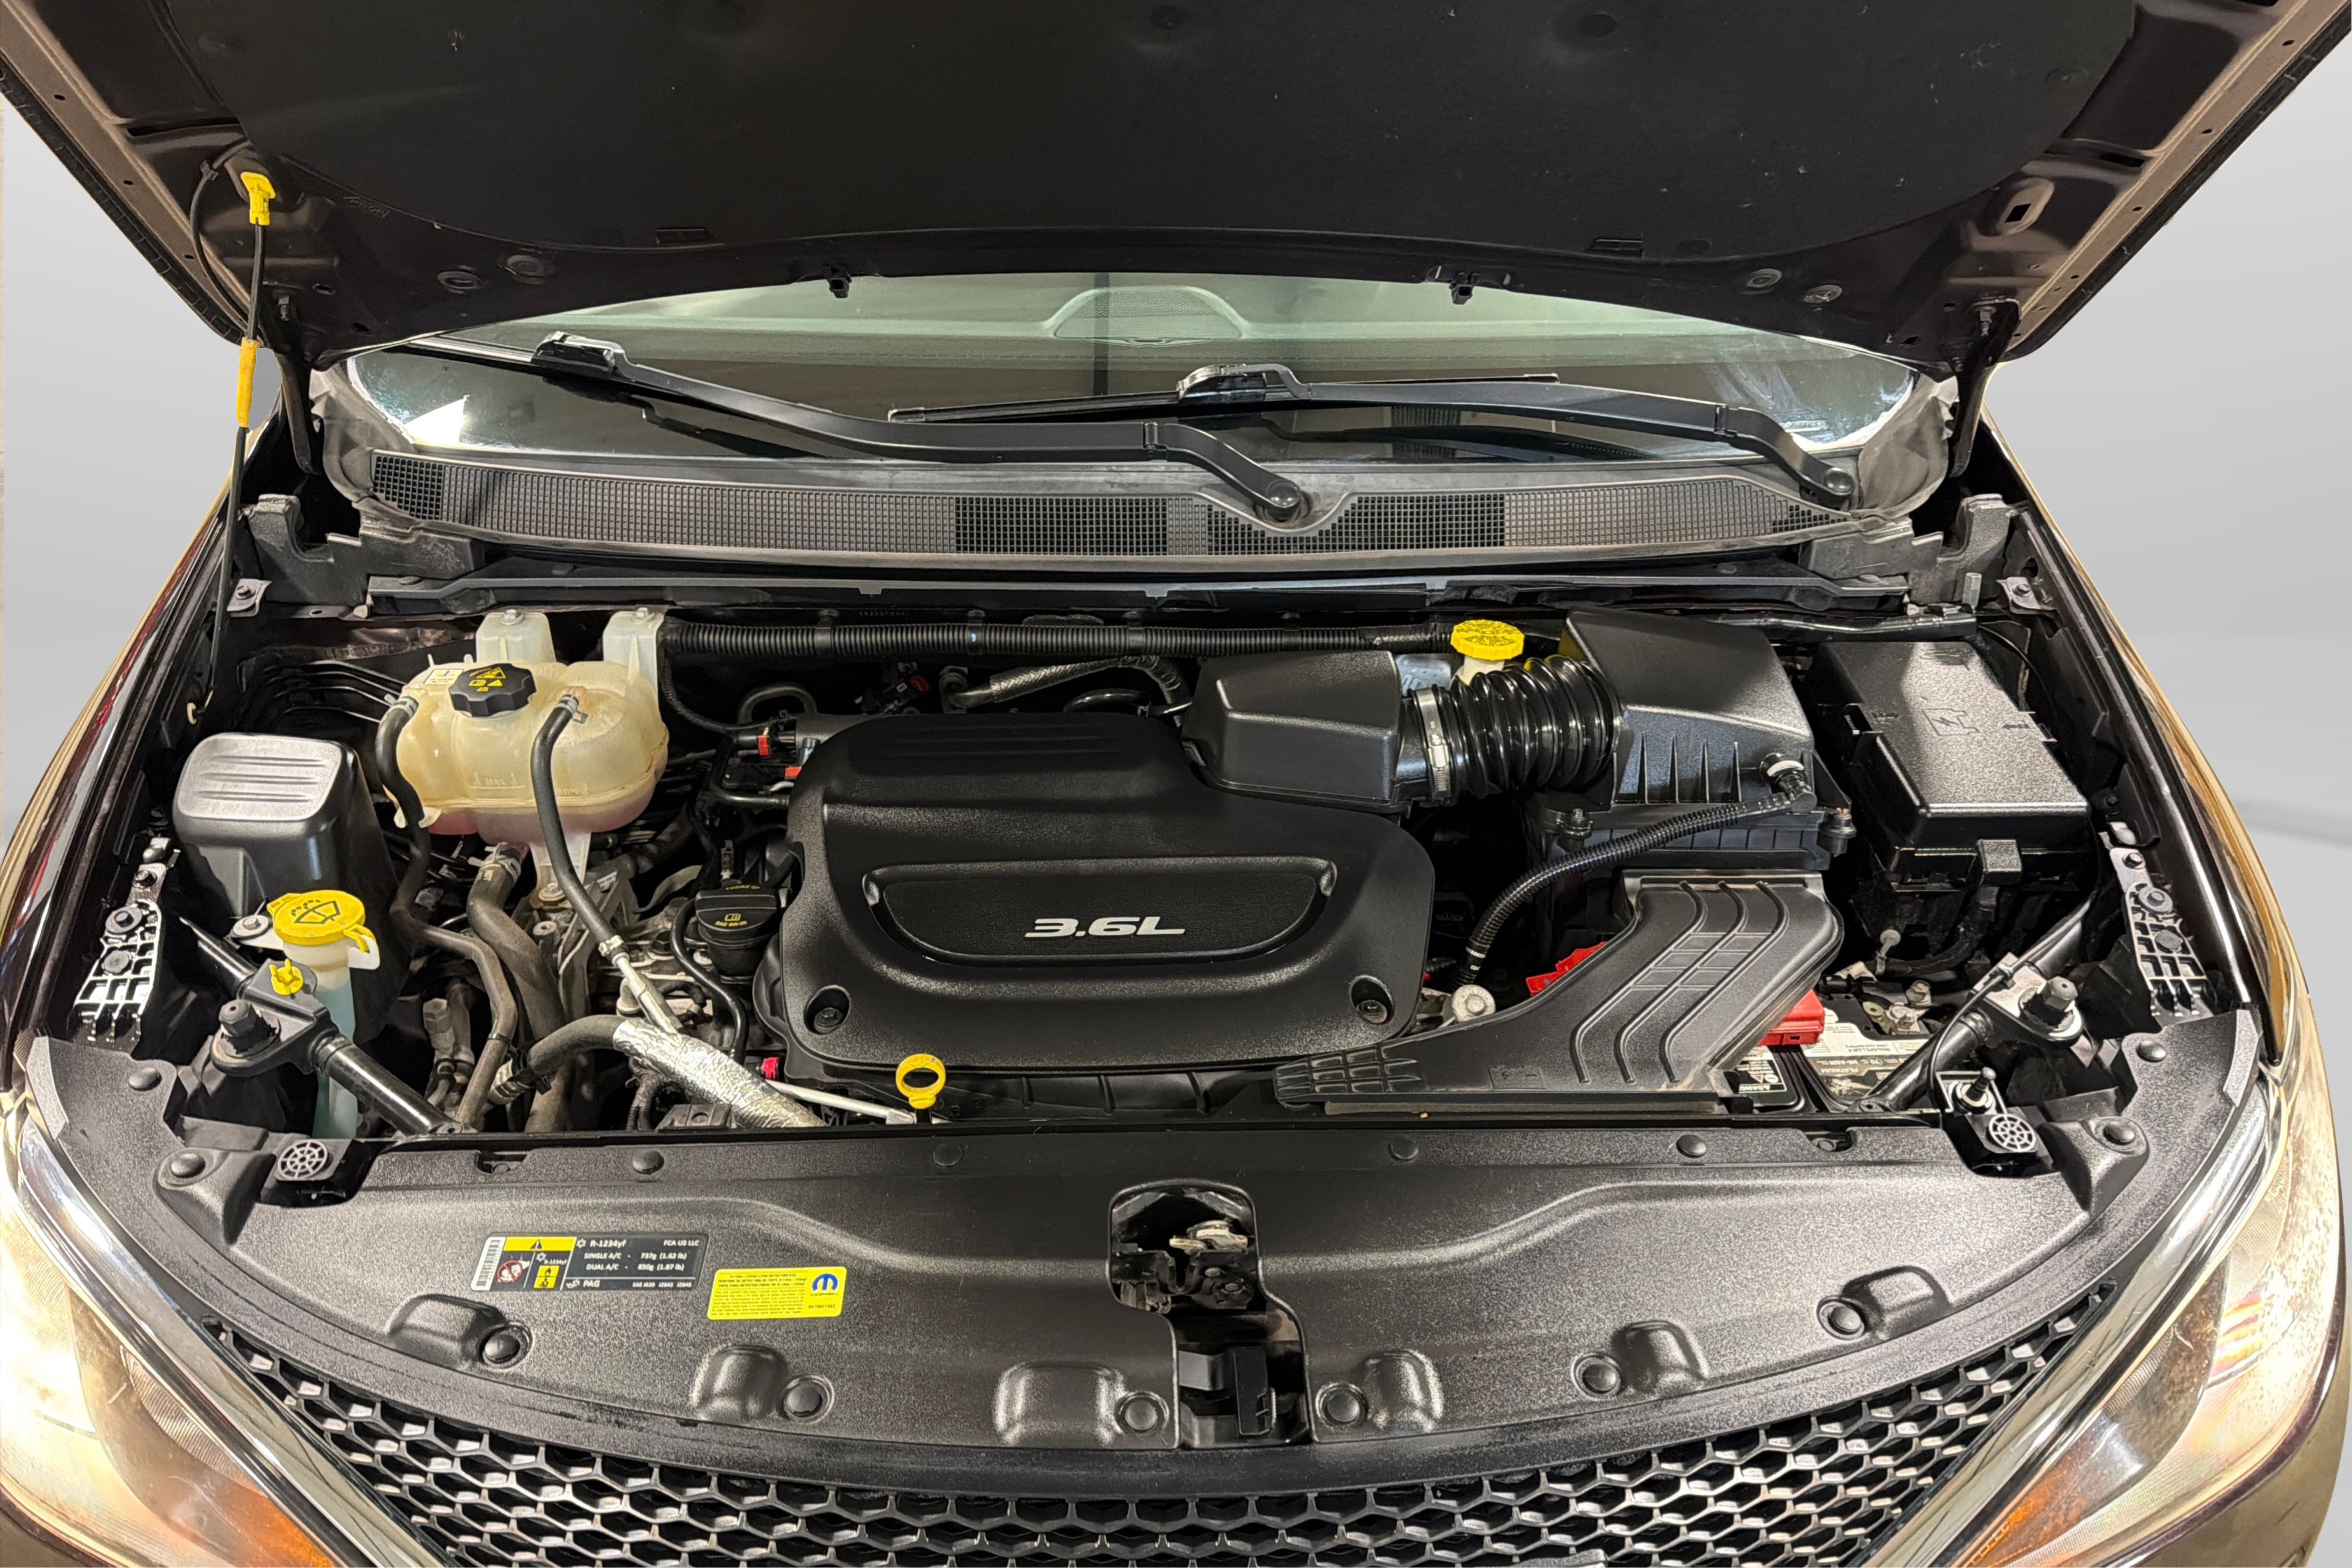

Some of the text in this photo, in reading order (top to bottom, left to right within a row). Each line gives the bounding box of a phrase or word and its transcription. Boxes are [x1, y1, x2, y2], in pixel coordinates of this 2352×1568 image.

[483, 869, 494, 881] HOT
[1024, 916, 1186, 938] 3.6L
[589, 1239, 627, 1249] R-1234yf
[608, 1252, 622, 1260] A/C
[640, 1252, 657, 1260] 737g
[677, 1252, 687, 1260] lb)
[675, 1263, 685, 1271] lb)
[583, 1279, 601, 1288] PAG
